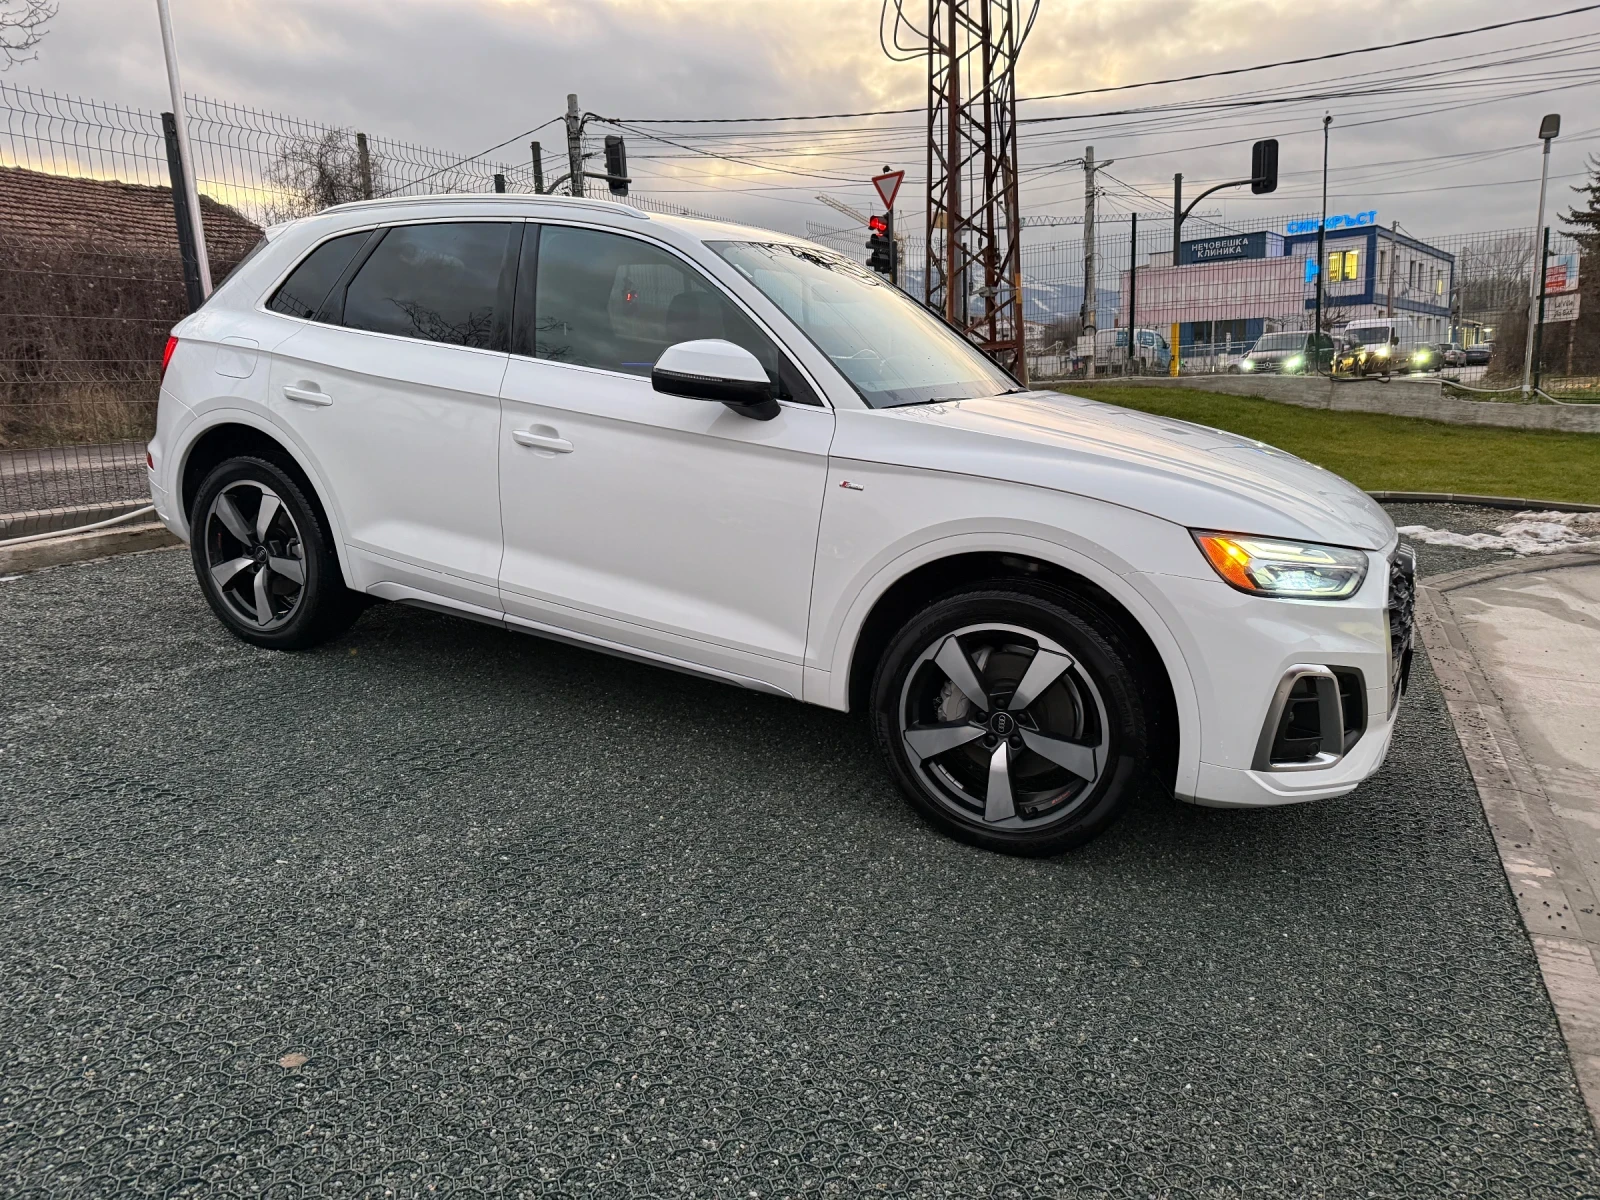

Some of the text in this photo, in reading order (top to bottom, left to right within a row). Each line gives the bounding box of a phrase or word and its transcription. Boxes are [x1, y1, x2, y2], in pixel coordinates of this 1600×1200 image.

[1287, 210, 1377, 234] СИН КРЪСТ
[1191, 238, 1249, 252] НЕЧОВЕШКА
[1197, 246, 1242, 258] КЛИНИКА
